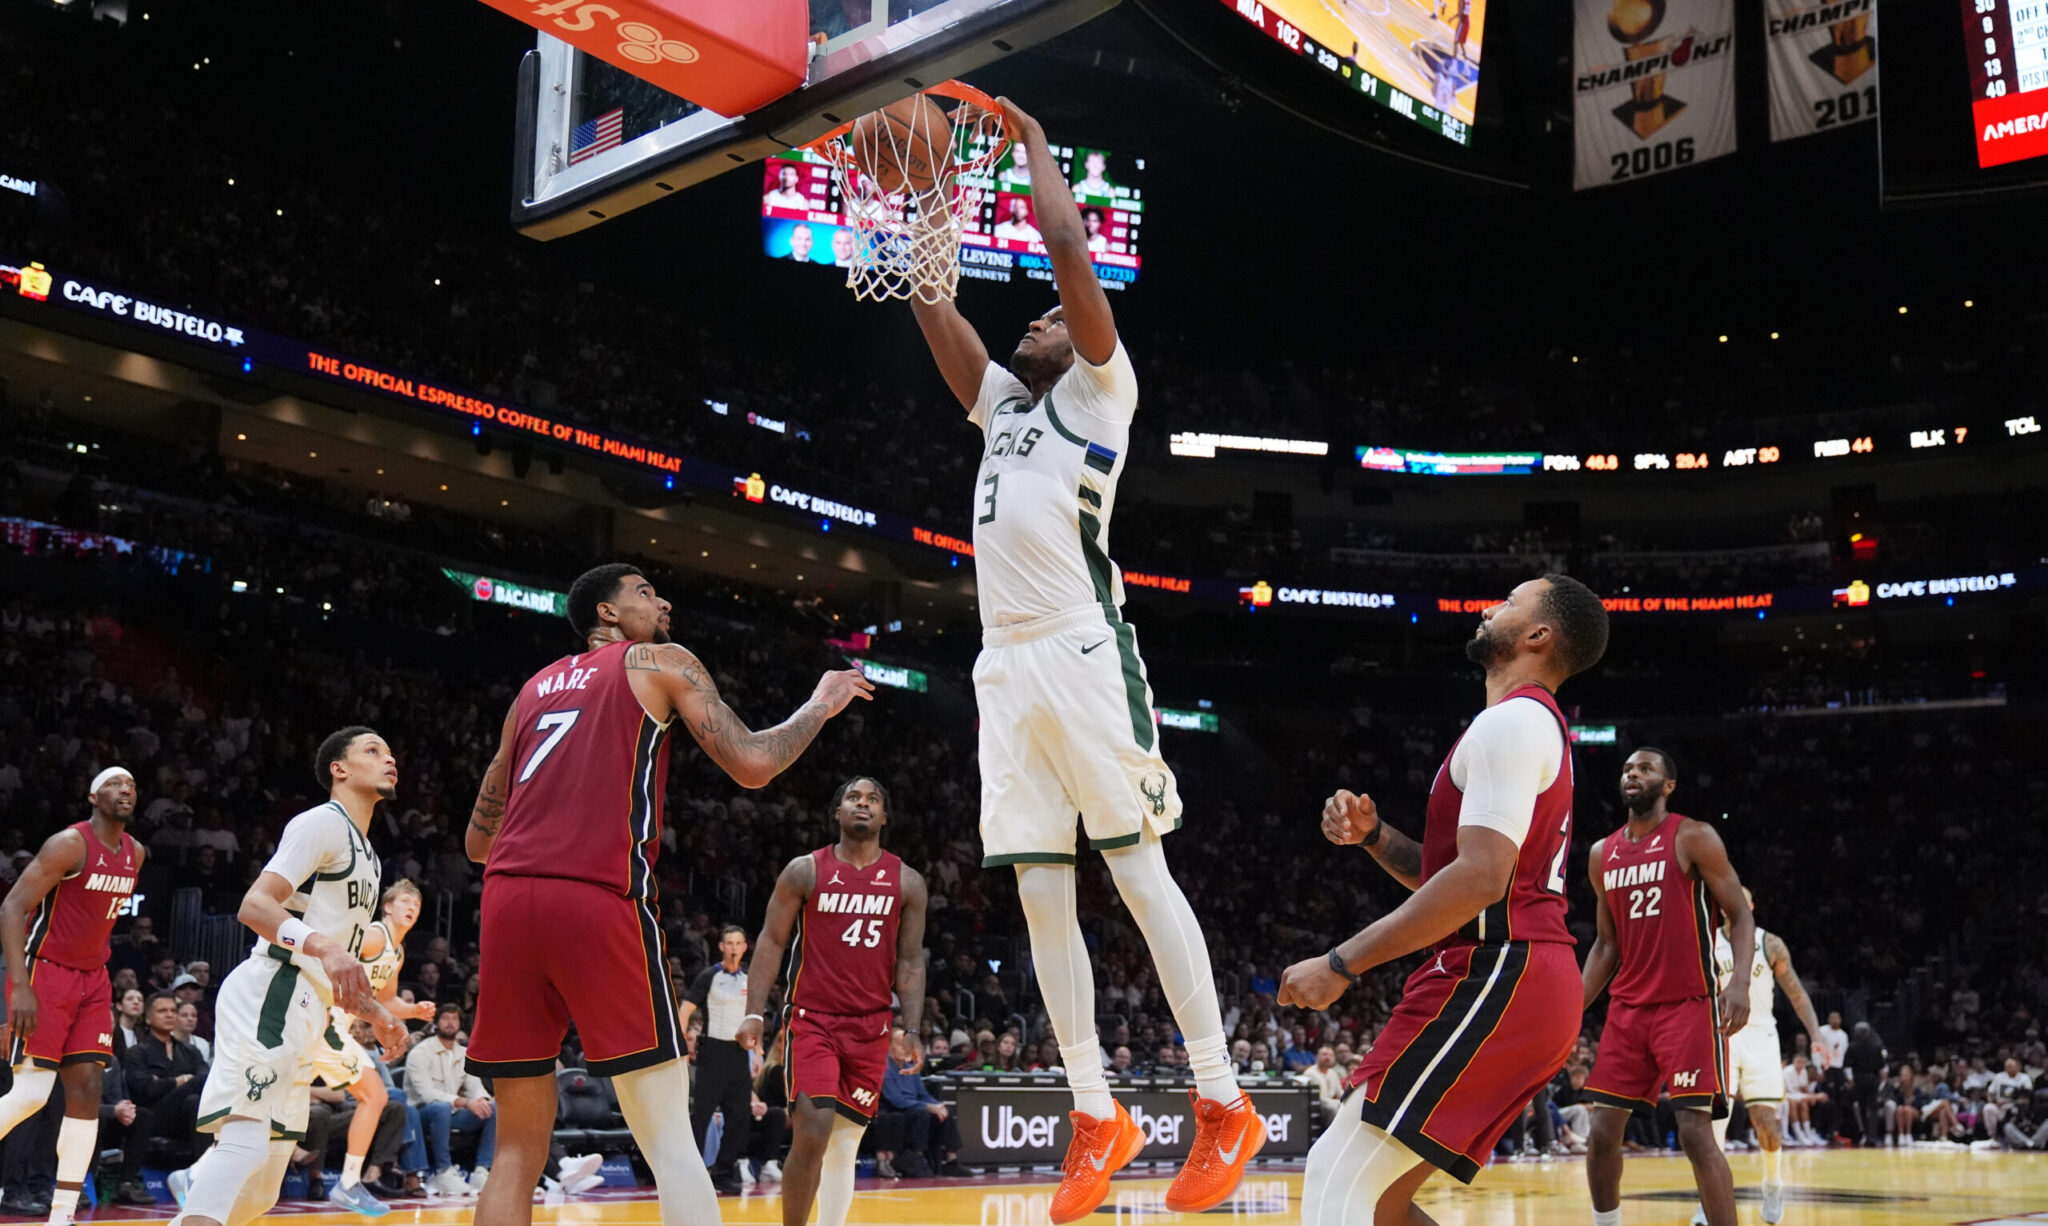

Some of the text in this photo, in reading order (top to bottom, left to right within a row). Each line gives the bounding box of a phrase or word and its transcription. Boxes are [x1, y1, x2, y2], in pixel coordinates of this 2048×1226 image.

[526, 0, 620, 31] St
[1237, 0, 1265, 28] MIA
[1276, 20, 1300, 50] 102
[1360, 72, 1417, 120] 91 MIL
[1985, 79, 2007, 98] 40
[1611, 137, 1694, 181] 2006
[962, 248, 1013, 268] LEVINE
[134, 301, 224, 343] BUSTELO
[308, 352, 682, 472] THE OFFICIAL ESPRESSO COFFEE OF THE MIAMI HEAT
[1723, 448, 1757, 466] AST
[1852, 436, 1874, 453] 44
[1910, 429, 1946, 448] BLK
[1954, 427, 1968, 444] 7
[811, 497, 864, 525] BUSTELO
[978, 473, 999, 526] 3
[912, 526, 976, 557] THE OFFICIA
[1161, 576, 1191, 592] HEAT
[1322, 590, 1381, 608] BUSTELO
[1929, 575, 1999, 595] BUSTELO
[1438, 598, 1462, 613] THE
[1600, 593, 1773, 611] OFFEE OF THE MIAMI HEAT
[537, 667, 598, 698] WARE
[518, 707, 583, 785] 7
[84, 873, 134, 894] MIAMI
[1603, 860, 1666, 891] MIAMI
[817, 893, 895, 915] MIAMI
[1629, 886, 1662, 920] 22
[841, 919, 884, 948] 45
[981, 1105, 1060, 1149] Uber
